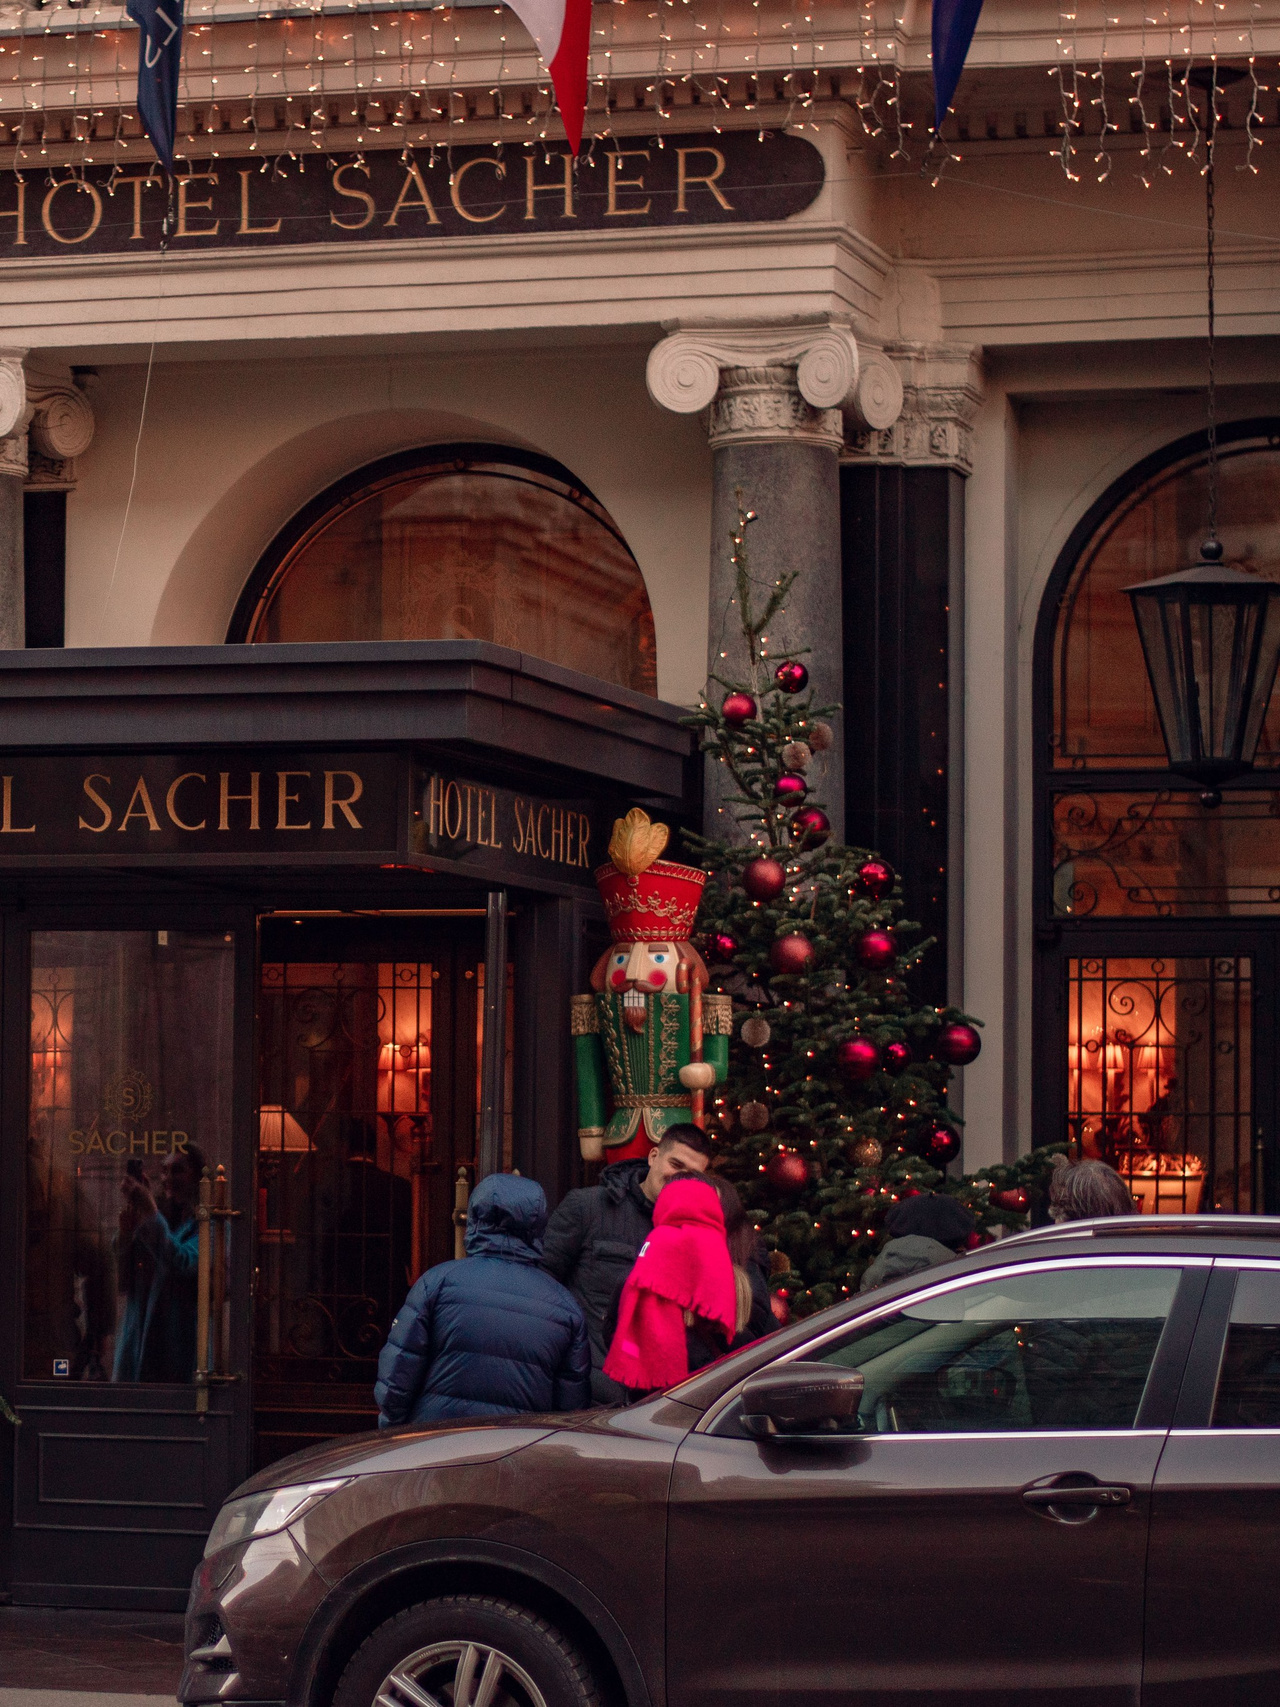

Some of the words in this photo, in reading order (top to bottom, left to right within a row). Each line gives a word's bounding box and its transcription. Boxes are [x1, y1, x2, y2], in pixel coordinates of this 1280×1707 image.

[330, 147, 735, 230] SACHER
[78, 771, 363, 832] SACHER
[429, 776, 502, 849] HOTEL
[512, 797, 591, 868] SACHER
[71, 1131, 188, 1155] SACHER
